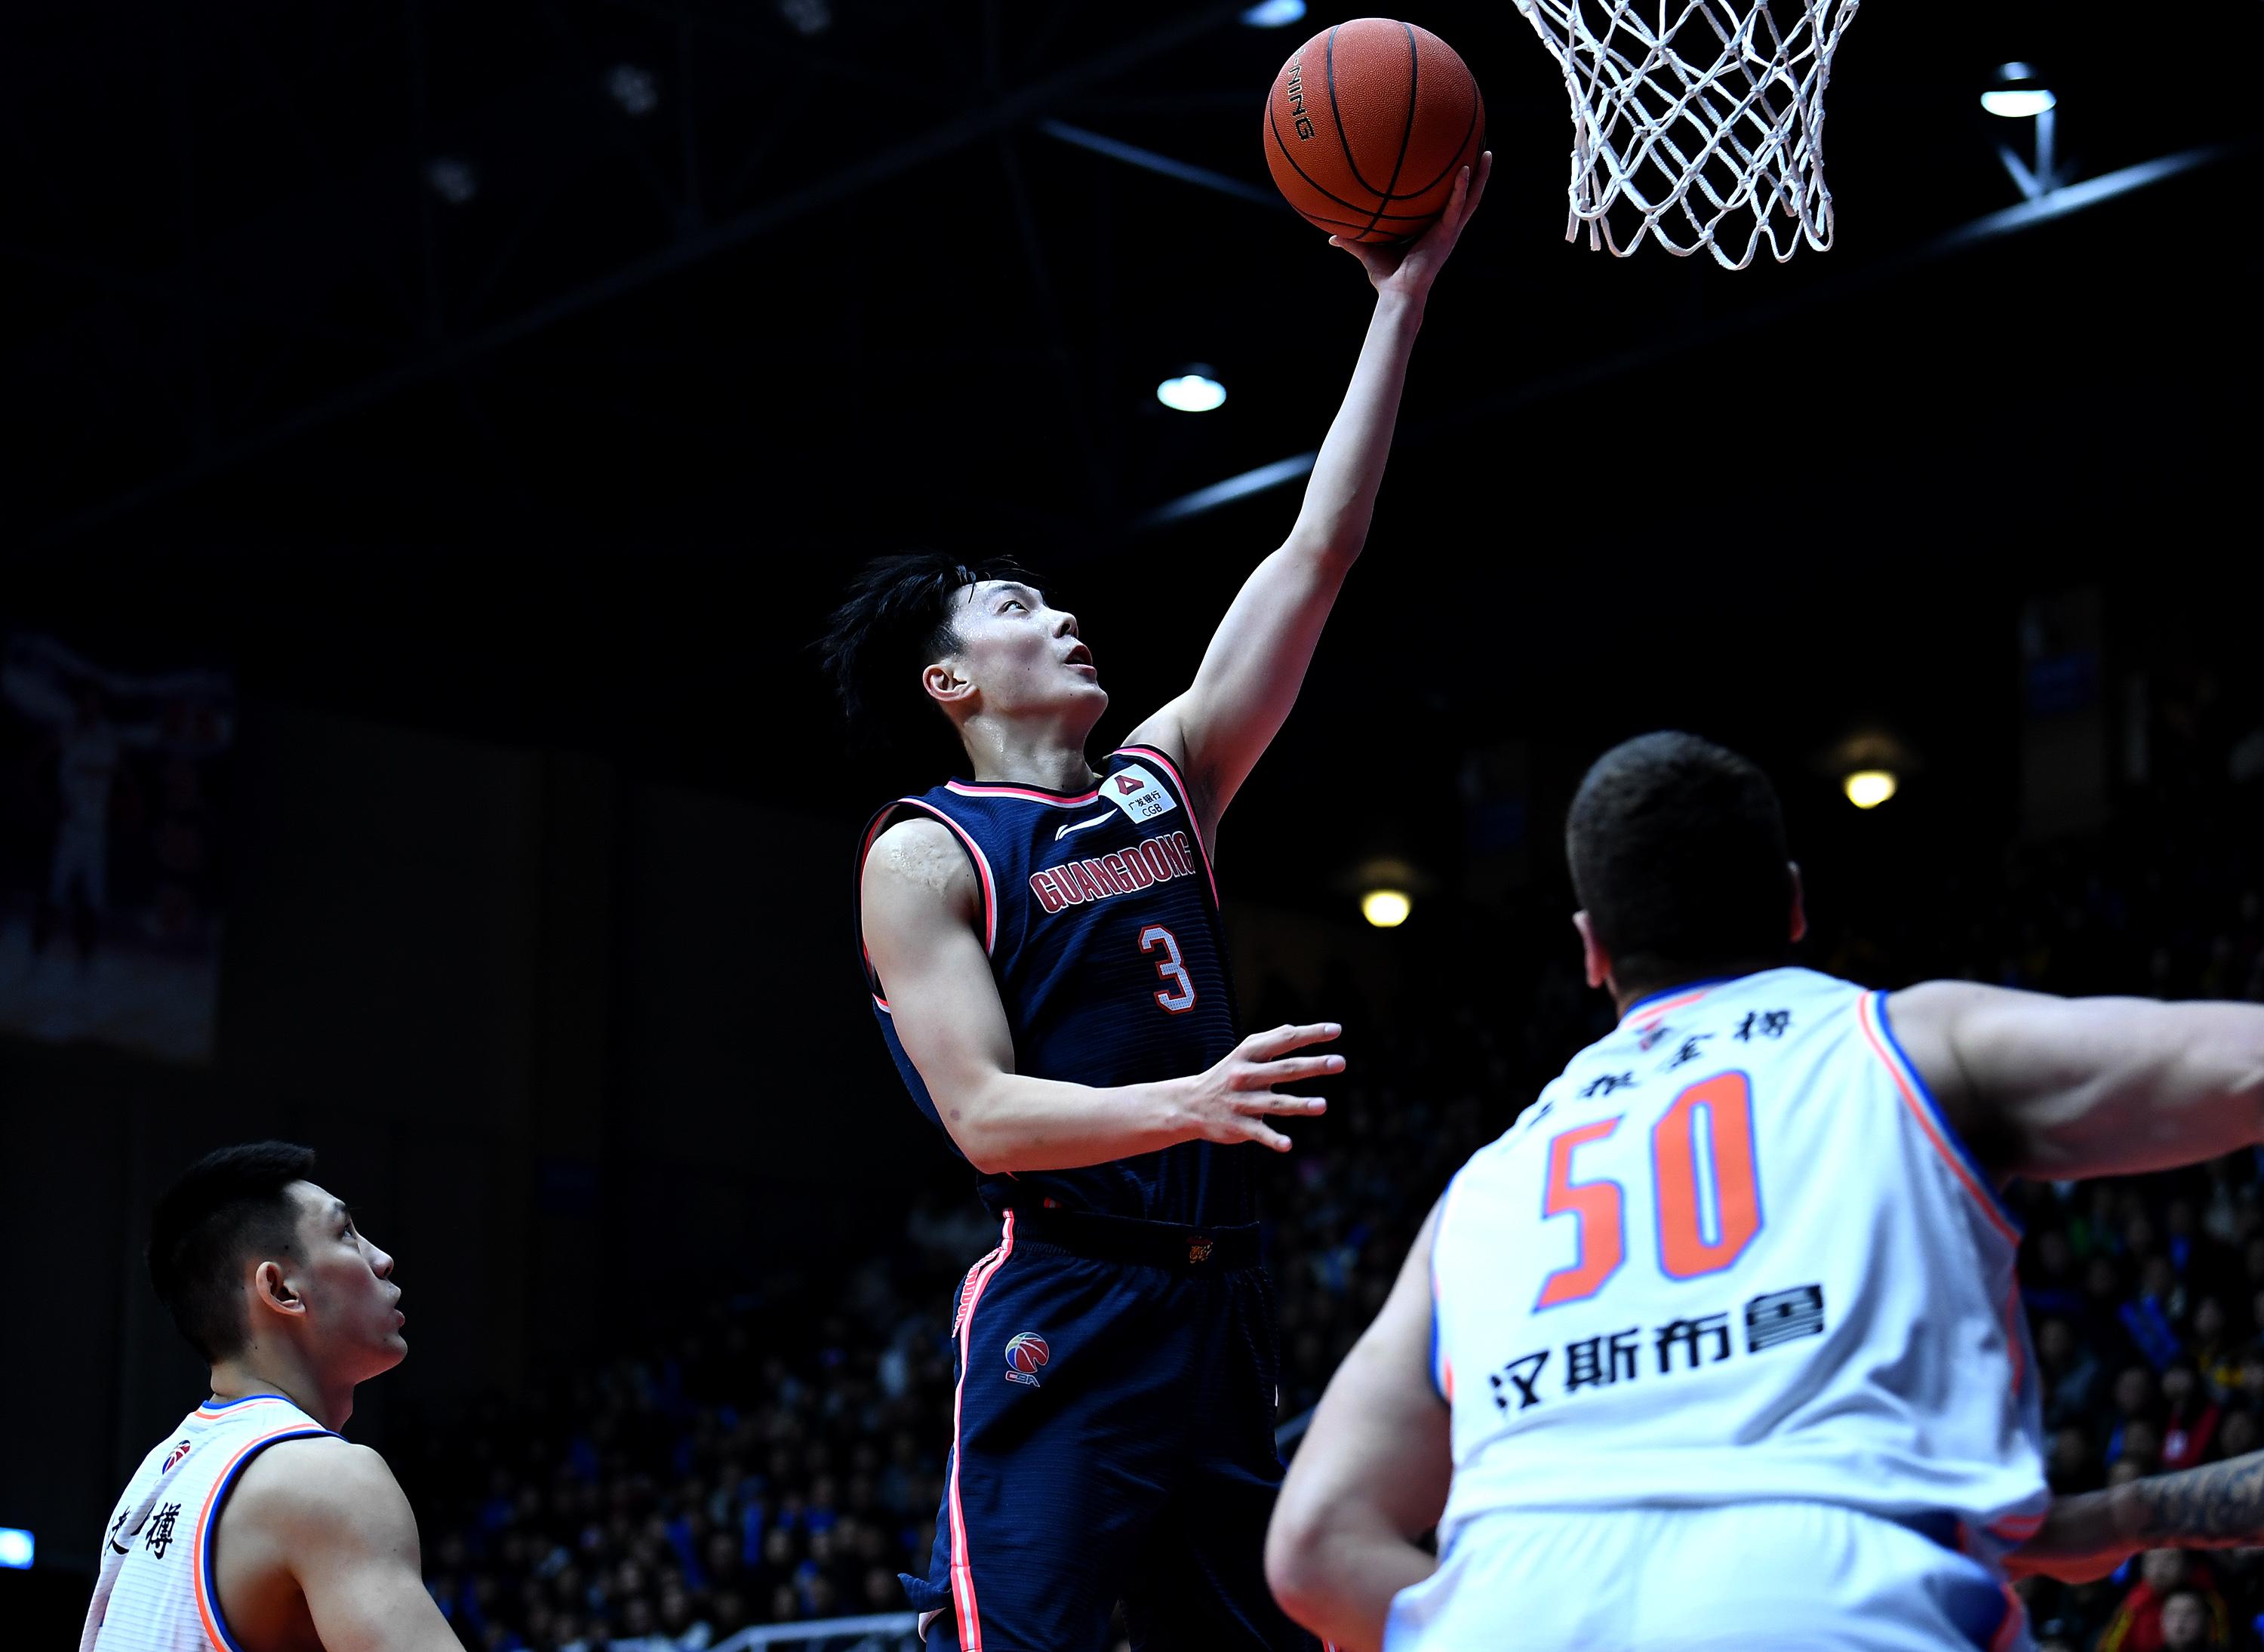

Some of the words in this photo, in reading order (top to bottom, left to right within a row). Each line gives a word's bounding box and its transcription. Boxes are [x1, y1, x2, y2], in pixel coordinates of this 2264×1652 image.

[1128, 790, 1161, 811] 广发银行
[1142, 803, 1163, 817] CGB
[1029, 831, 1195, 914] GUANGDONG
[1138, 924, 1198, 1014] 3
[1532, 1067, 1765, 1315] 50
[1004, 1371, 1041, 1388] CBA
[1488, 1283, 1824, 1409] 汉斯布鲁
